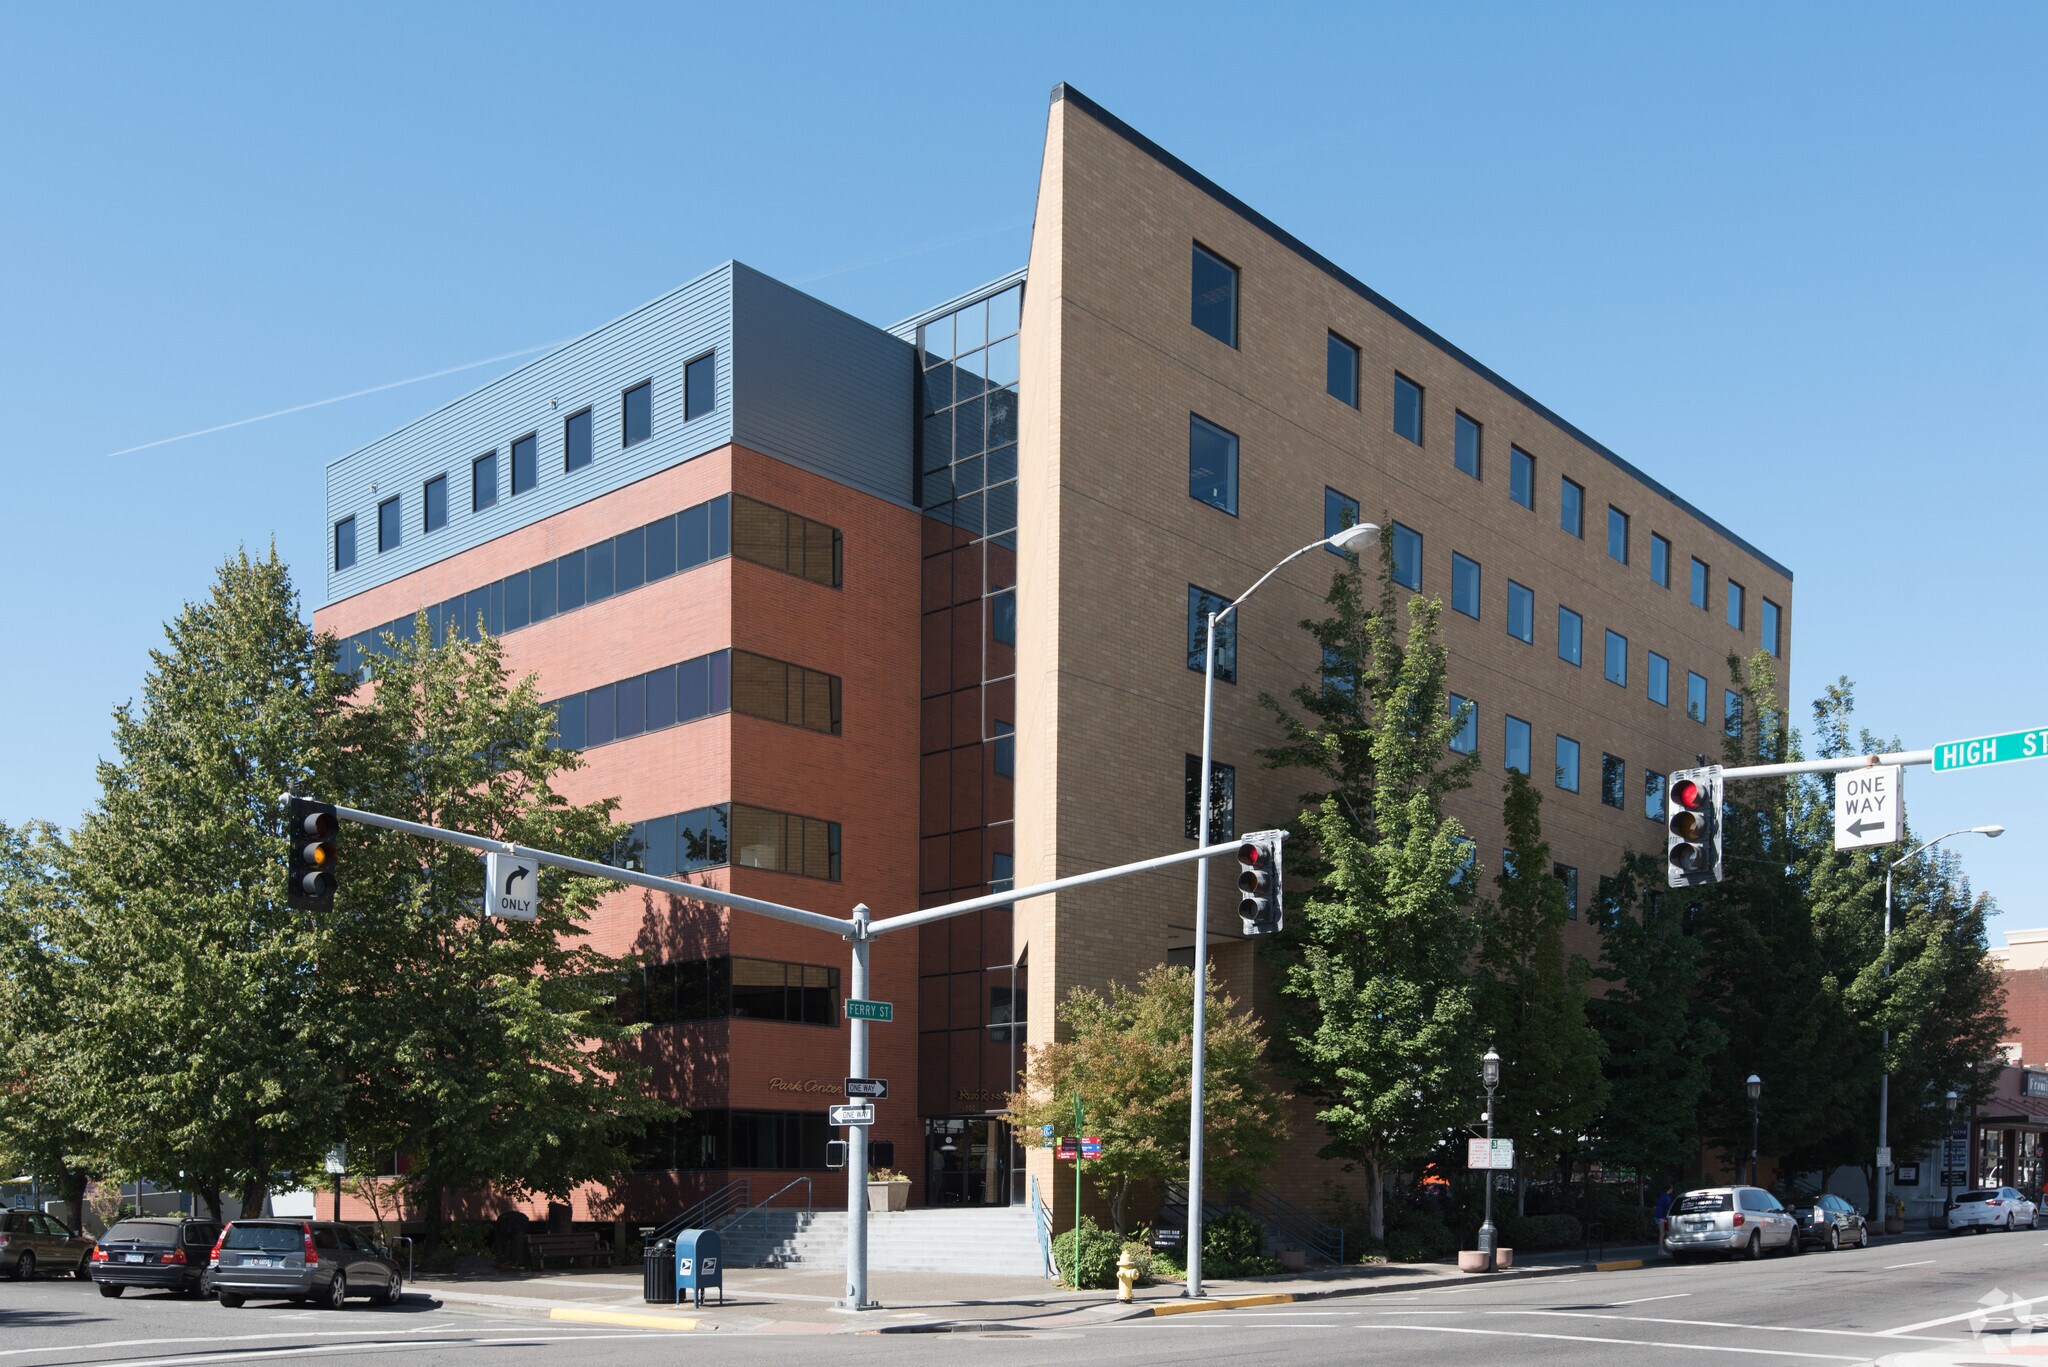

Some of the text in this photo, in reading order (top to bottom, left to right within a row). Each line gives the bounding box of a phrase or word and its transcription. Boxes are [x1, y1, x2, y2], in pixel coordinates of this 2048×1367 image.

[1943, 731, 2048, 768] HIGH ST
[1847, 776, 1885, 795] ONE
[1846, 795, 1886, 815] WAY
[501, 897, 531, 911] ONLY
[849, 1003, 889, 1018] FERRY ST
[769, 1077, 843, 1094] Park Center
[849, 1084, 876, 1092] ONE WAY
[856, 1110, 869, 1118] WAY
